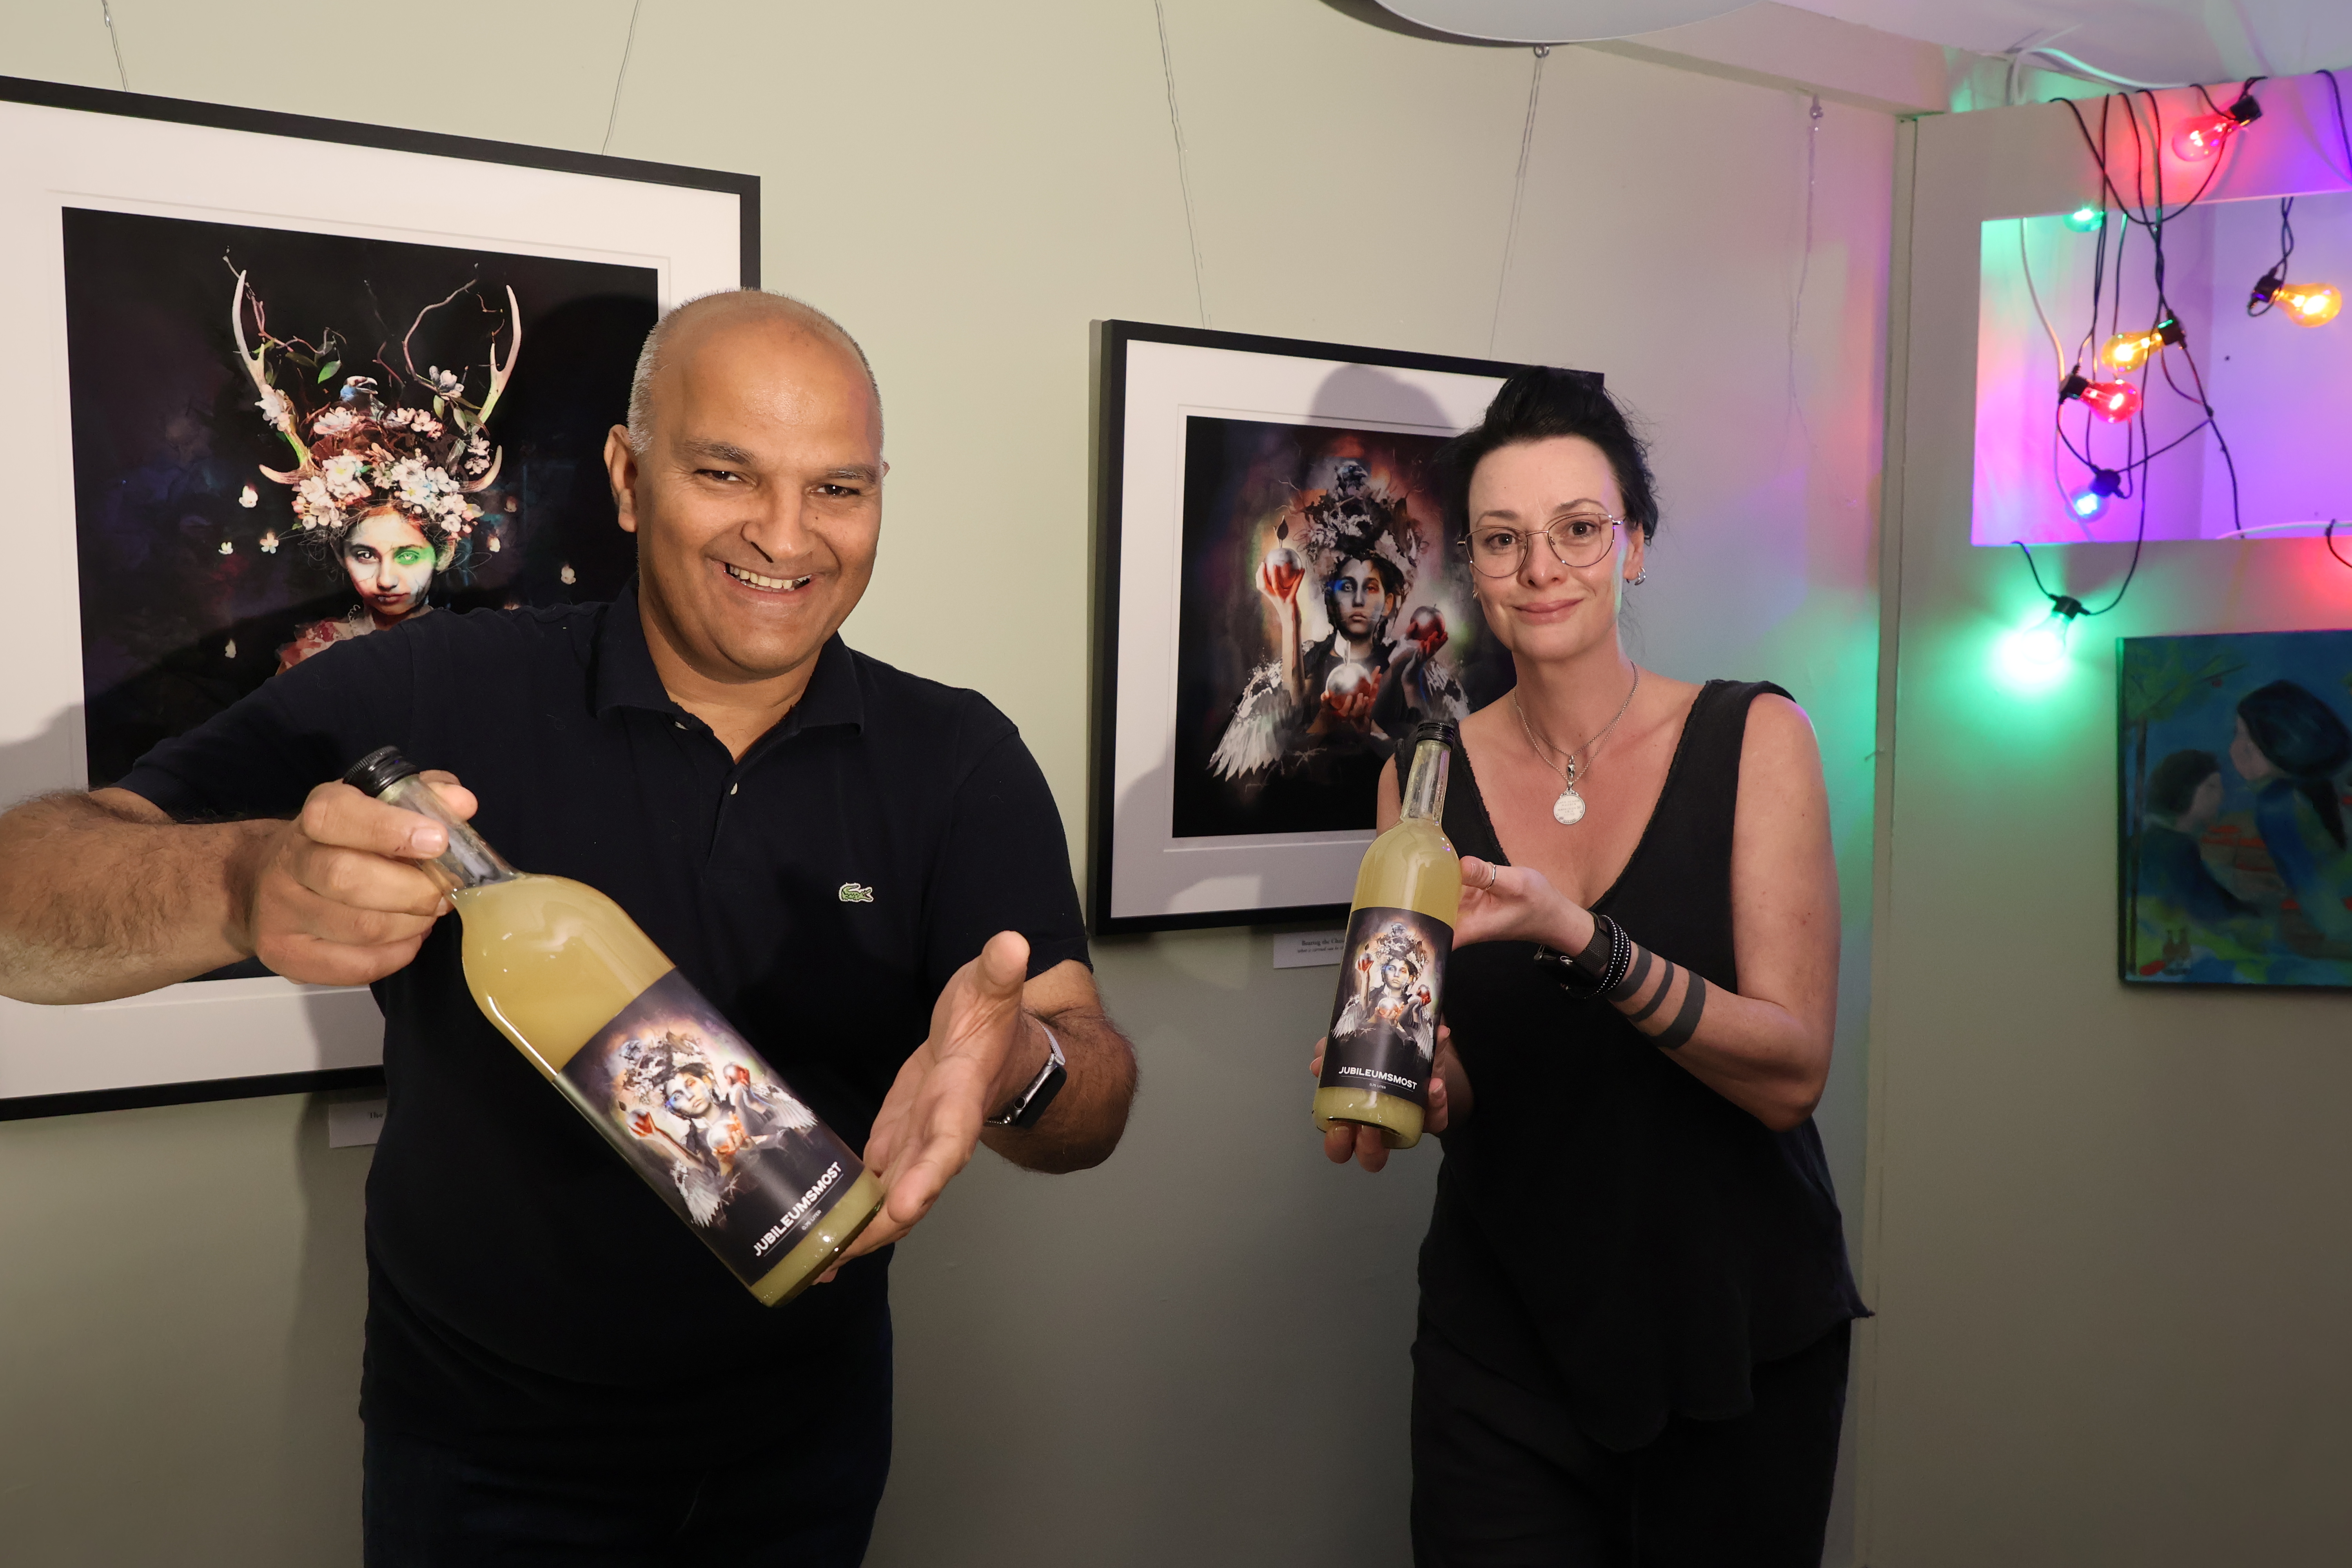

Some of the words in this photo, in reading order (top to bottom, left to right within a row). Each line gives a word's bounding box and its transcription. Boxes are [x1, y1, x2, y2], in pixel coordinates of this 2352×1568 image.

[1339, 1066, 1417, 1089] JUBILEUMSMOST
[753, 1161, 842, 1256] JUBILEUMSMOST
[810, 1210, 822, 1221] LITER
